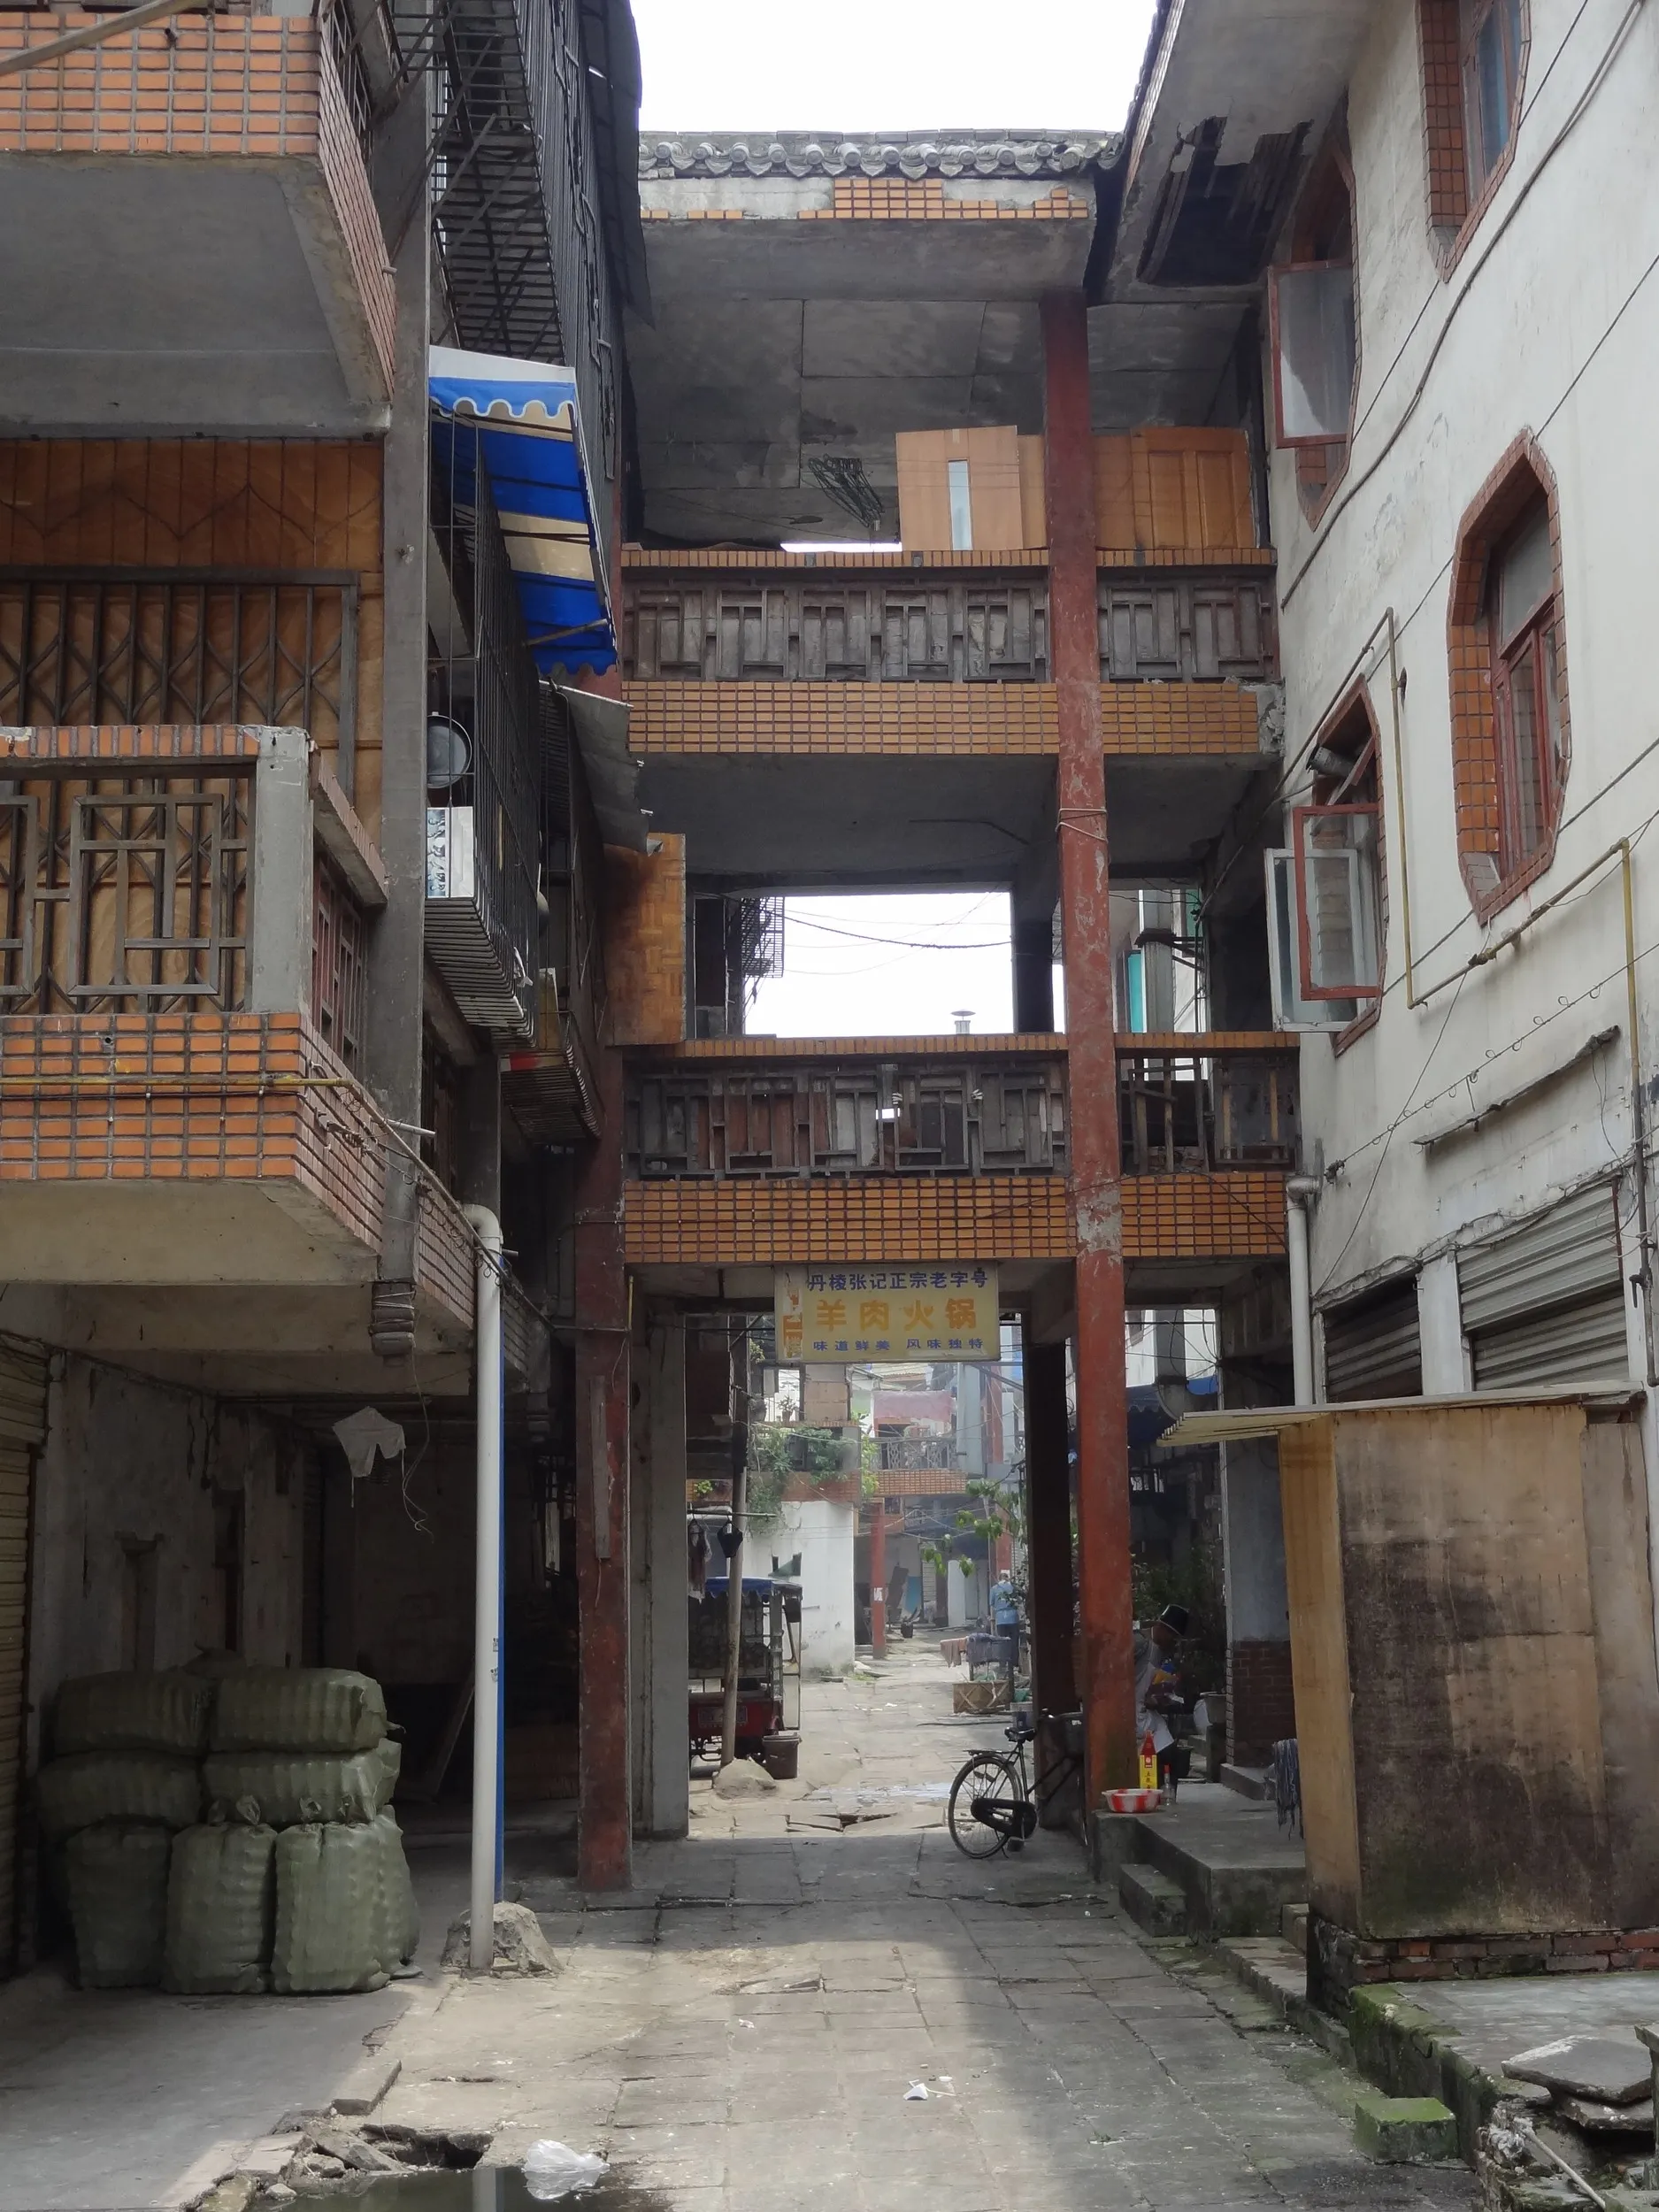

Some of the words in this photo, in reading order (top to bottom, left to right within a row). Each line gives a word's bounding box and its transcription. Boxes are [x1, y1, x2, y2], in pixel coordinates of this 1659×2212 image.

[816, 1298, 977, 1332] 羊肉火锅
[813, 1340, 890, 1351] 味道鲜美
[906, 1338, 983, 1349] 风味独特
